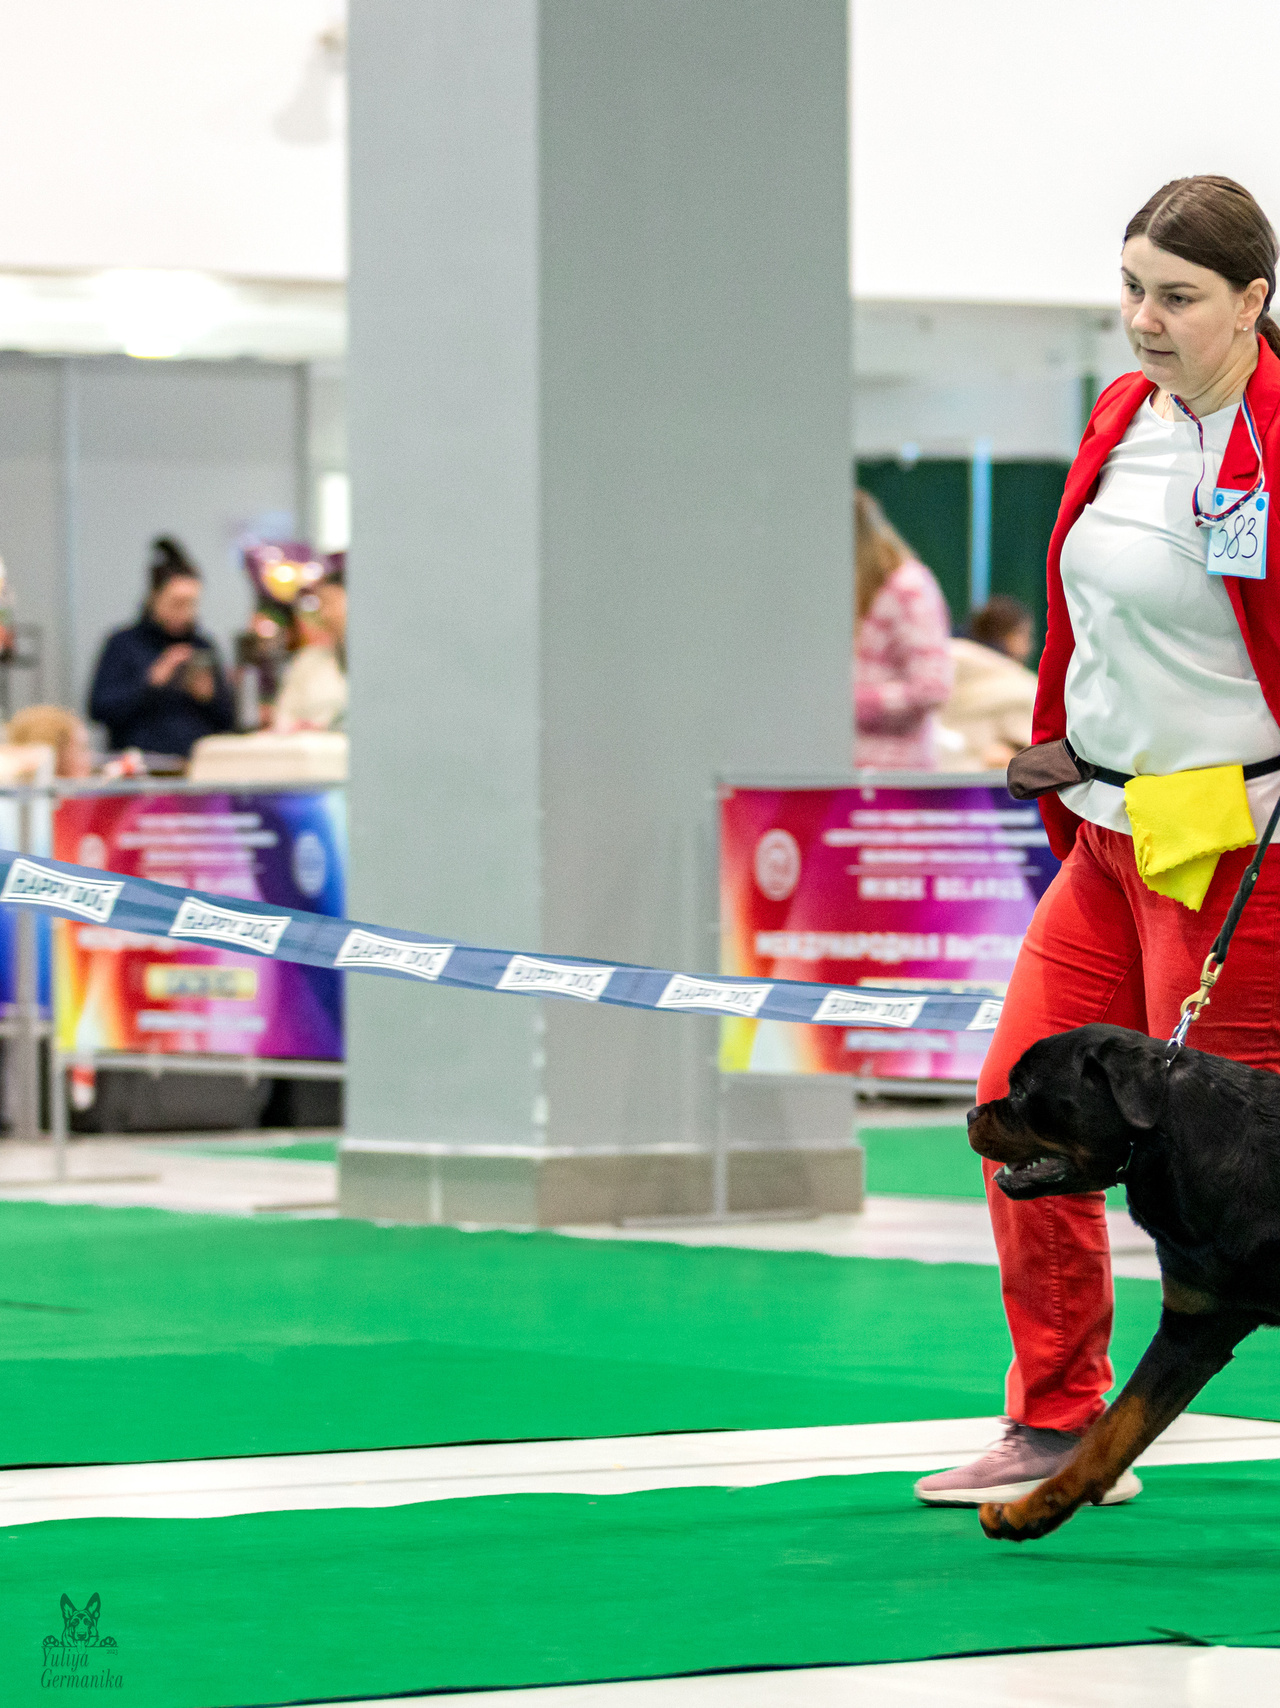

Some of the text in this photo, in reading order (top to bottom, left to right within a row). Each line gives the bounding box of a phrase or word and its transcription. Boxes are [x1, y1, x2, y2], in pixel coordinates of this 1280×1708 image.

[12, 869, 113, 912] HAPPY DOG
[180, 907, 281, 945] HAPPY DOG
[345, 936, 444, 971] HAPPY DOG
[509, 964, 605, 992] HAPPY DOG
[670, 982, 762, 1008] HAPPY DOG
[880, 1001, 918, 1020] DOG
